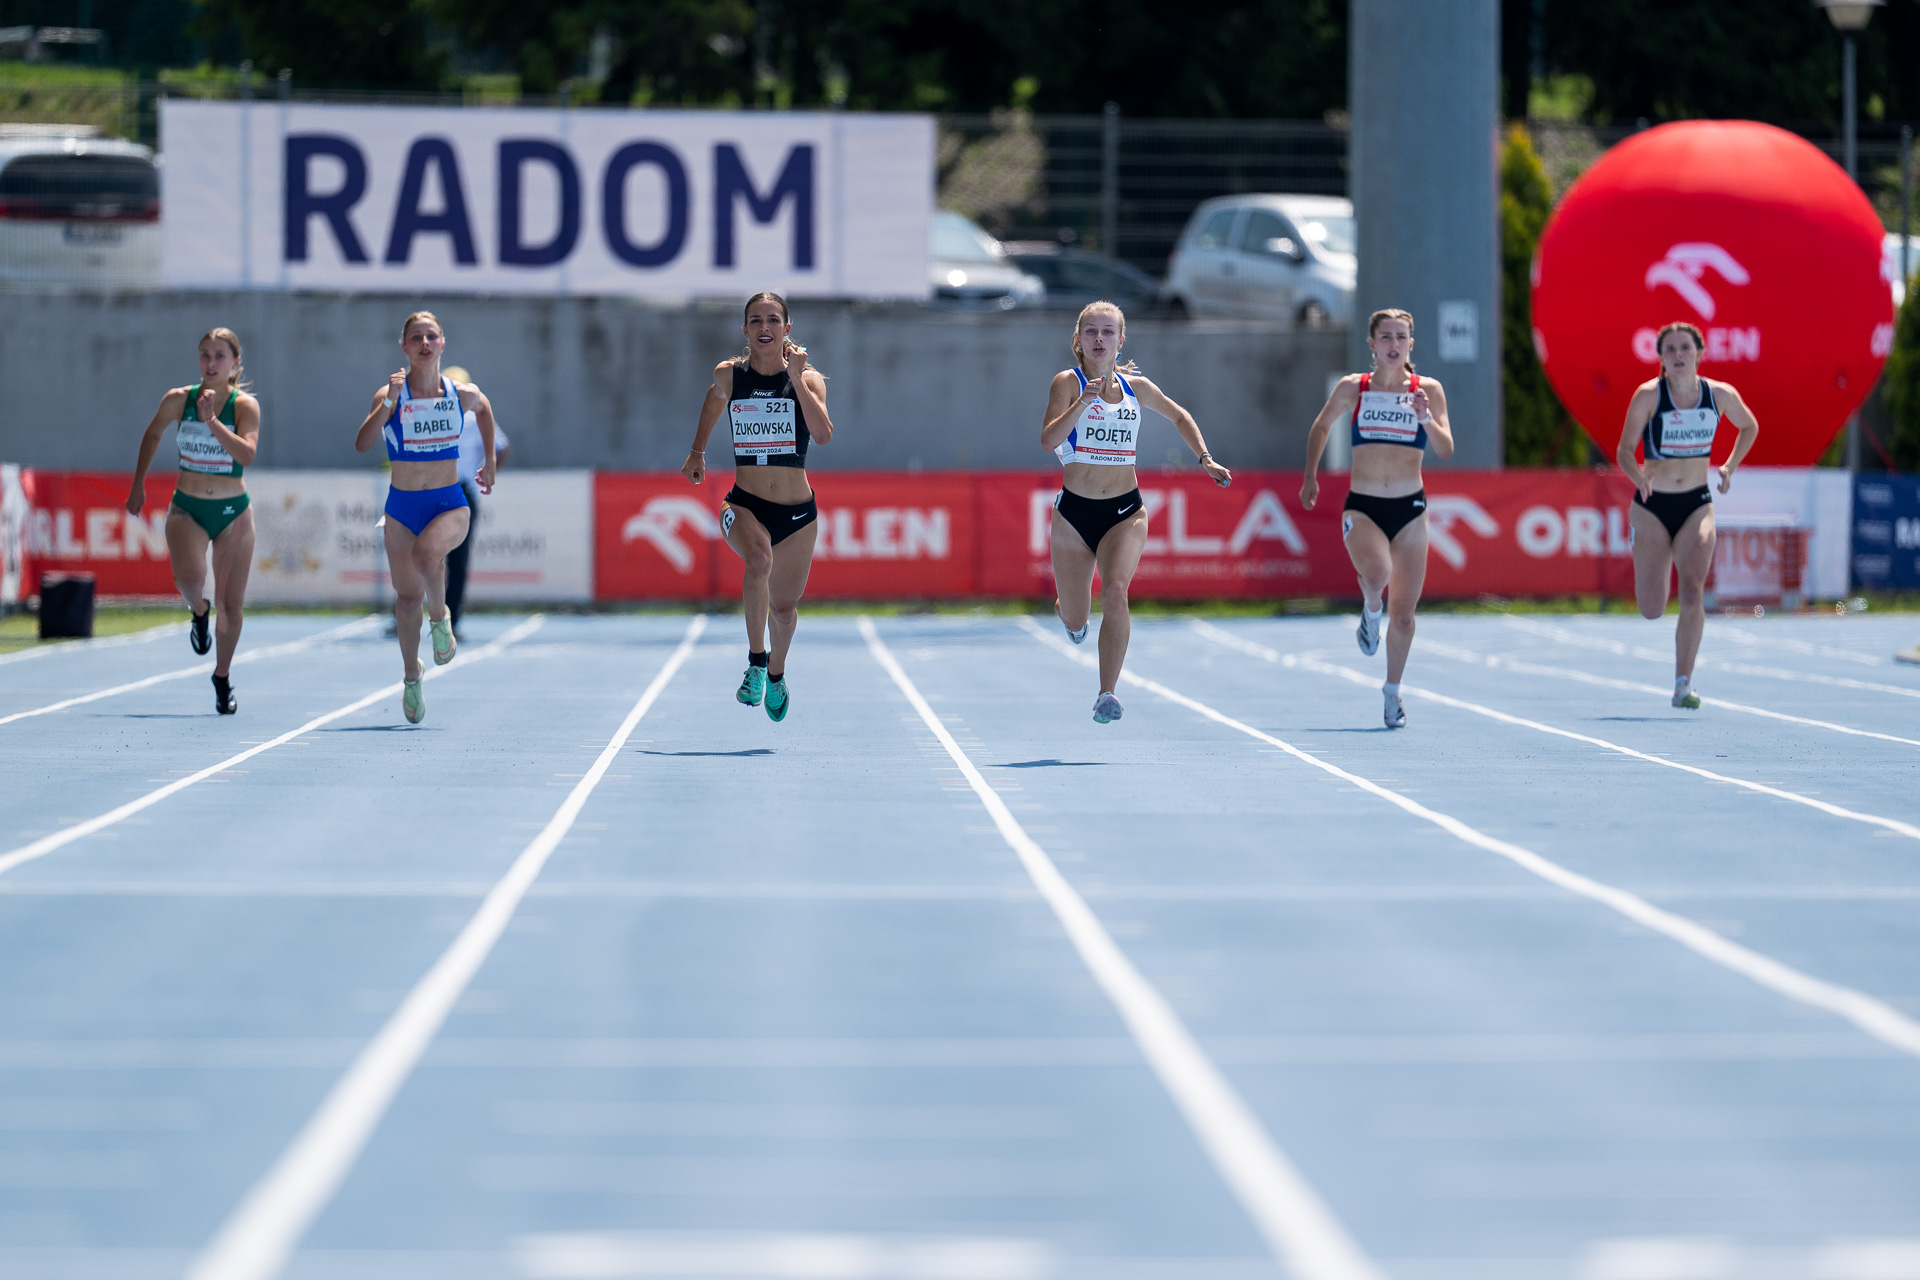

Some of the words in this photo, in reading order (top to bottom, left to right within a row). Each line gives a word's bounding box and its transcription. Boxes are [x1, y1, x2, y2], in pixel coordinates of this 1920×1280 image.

[283, 131, 816, 272] RADOM
[1631, 326, 1760, 364] OEN
[434, 400, 455, 412] 482
[766, 402, 789, 413] 521
[1117, 408, 1136, 420] 125
[1363, 410, 1415, 424] GUSZPIT
[414, 419, 453, 434] BĄBEL
[735, 420, 793, 435] ŻUKOWSKA
[1086, 427, 1132, 444] POJĘTA
[1516, 505, 1633, 559] ORL
